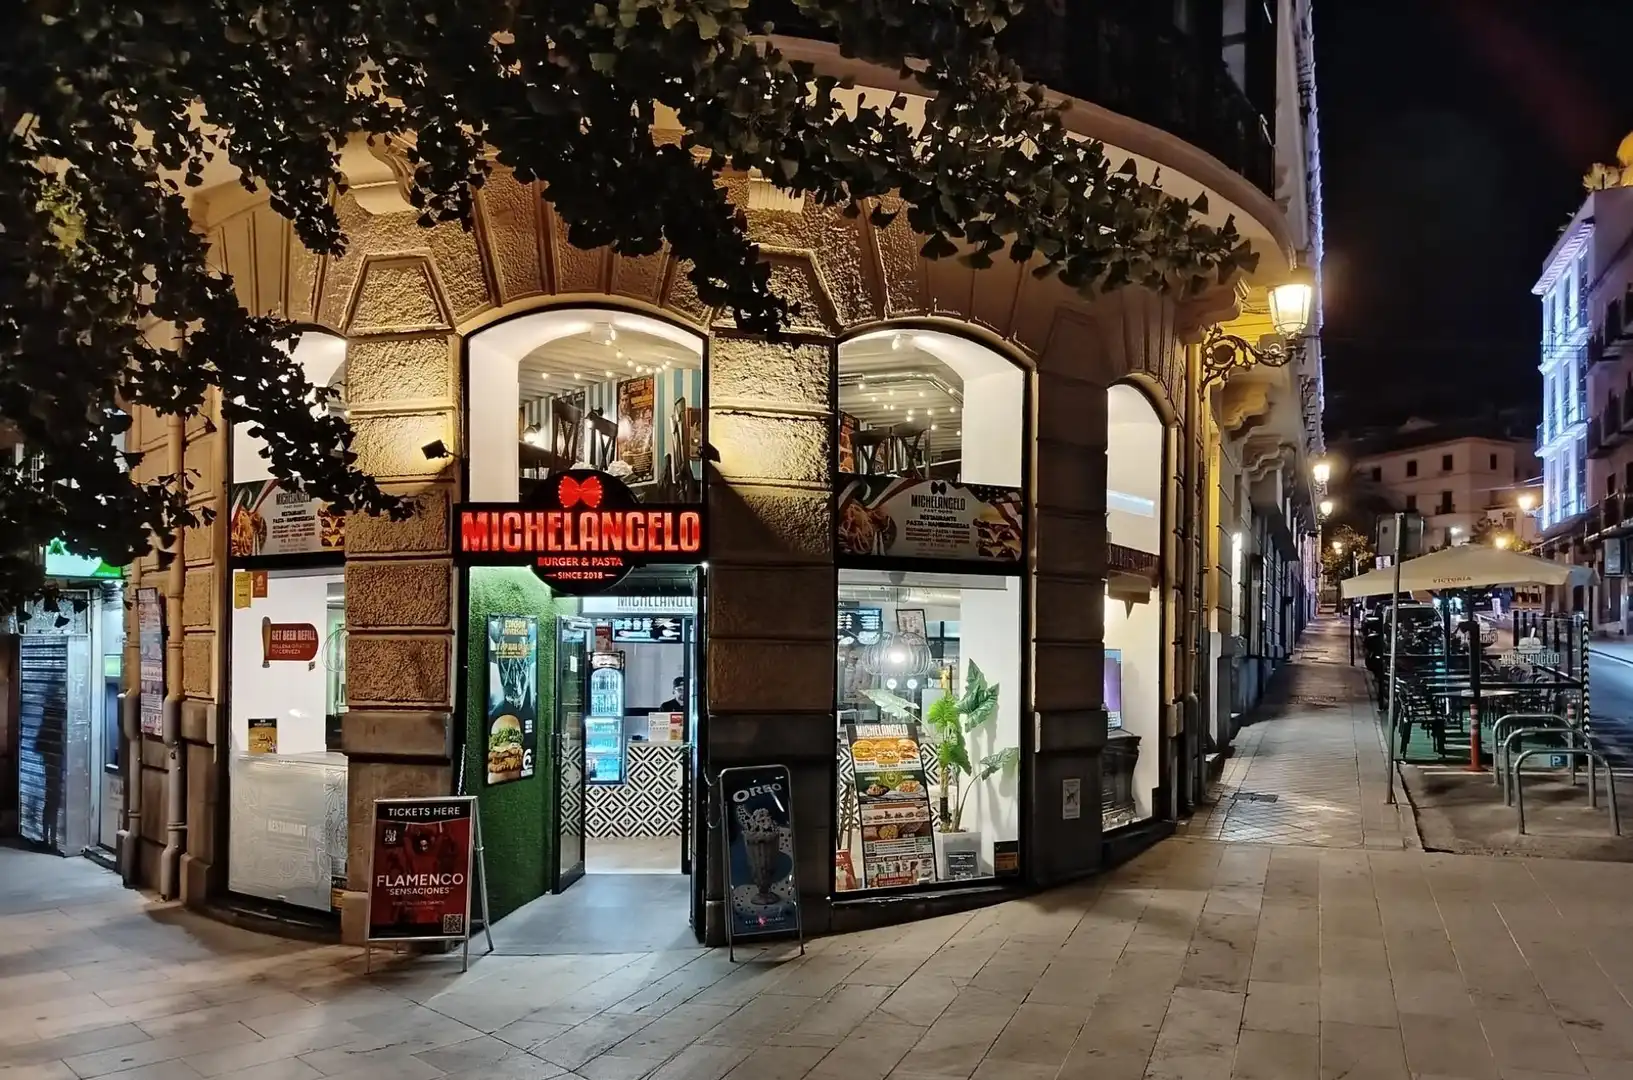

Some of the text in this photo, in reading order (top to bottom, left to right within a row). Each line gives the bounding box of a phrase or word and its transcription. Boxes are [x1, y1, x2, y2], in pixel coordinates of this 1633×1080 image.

[911, 494, 966, 510] MICHELANGELO
[461, 512, 700, 551] MICHELANGELO
[538, 557, 624, 567] BURGER & PASTA
[1433, 576, 1472, 584] VICTORIA
[271, 630, 282, 641] GET
[282, 630, 297, 641] BEER
[856, 724, 909, 737] MICHELANGELO
[733, 783, 782, 802] OREO
[388, 806, 461, 816] TICKETS HERE
[376, 873, 464, 887] FLAMENCO
